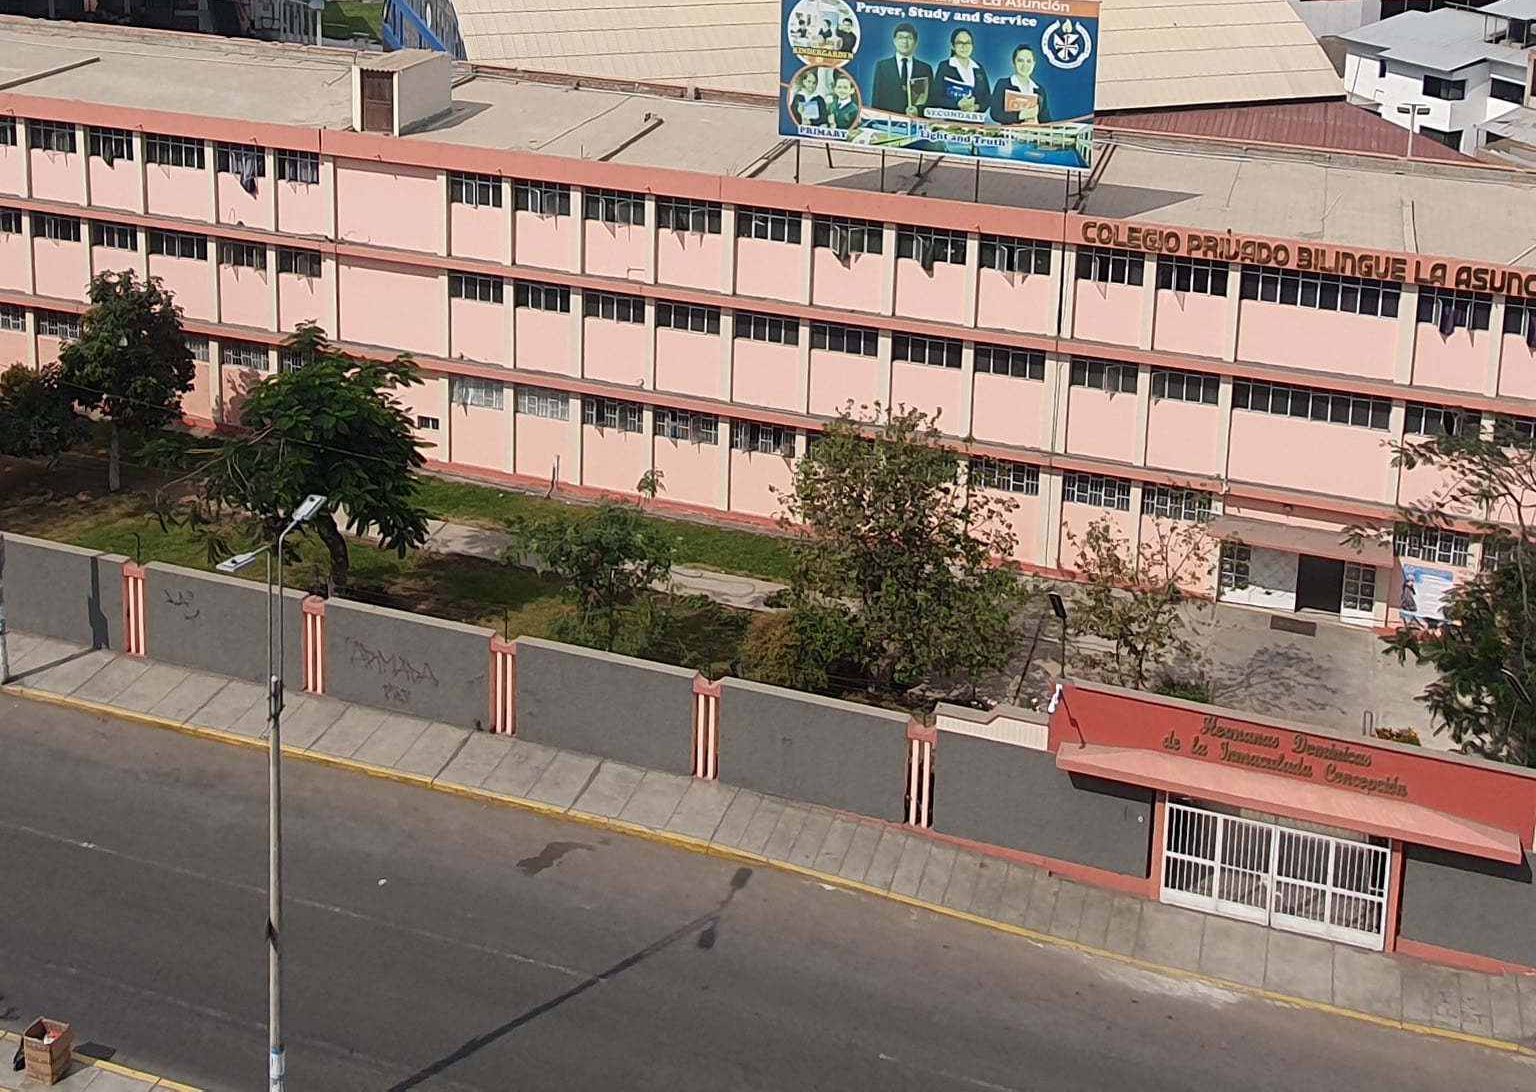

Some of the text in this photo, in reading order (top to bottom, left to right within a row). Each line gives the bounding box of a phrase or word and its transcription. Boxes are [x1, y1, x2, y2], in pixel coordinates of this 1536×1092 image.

[856, 1, 1038, 27] Prayer, Study and Service
[926, 109, 985, 121] SECONDARY
[800, 126, 848, 138] PRIMARY
[920, 130, 1006, 147] Light and Truth
[1081, 220, 1181, 253] COLEGIO
[1186, 233, 1290, 267] PRIVADO
[1296, 246, 1407, 282] BILINGUE
[1414, 260, 1448, 286] LA
[1200, 716, 1372, 768] Hermanas Dominicas
[1162, 730, 1408, 797] de la Inmaculada Concepción
